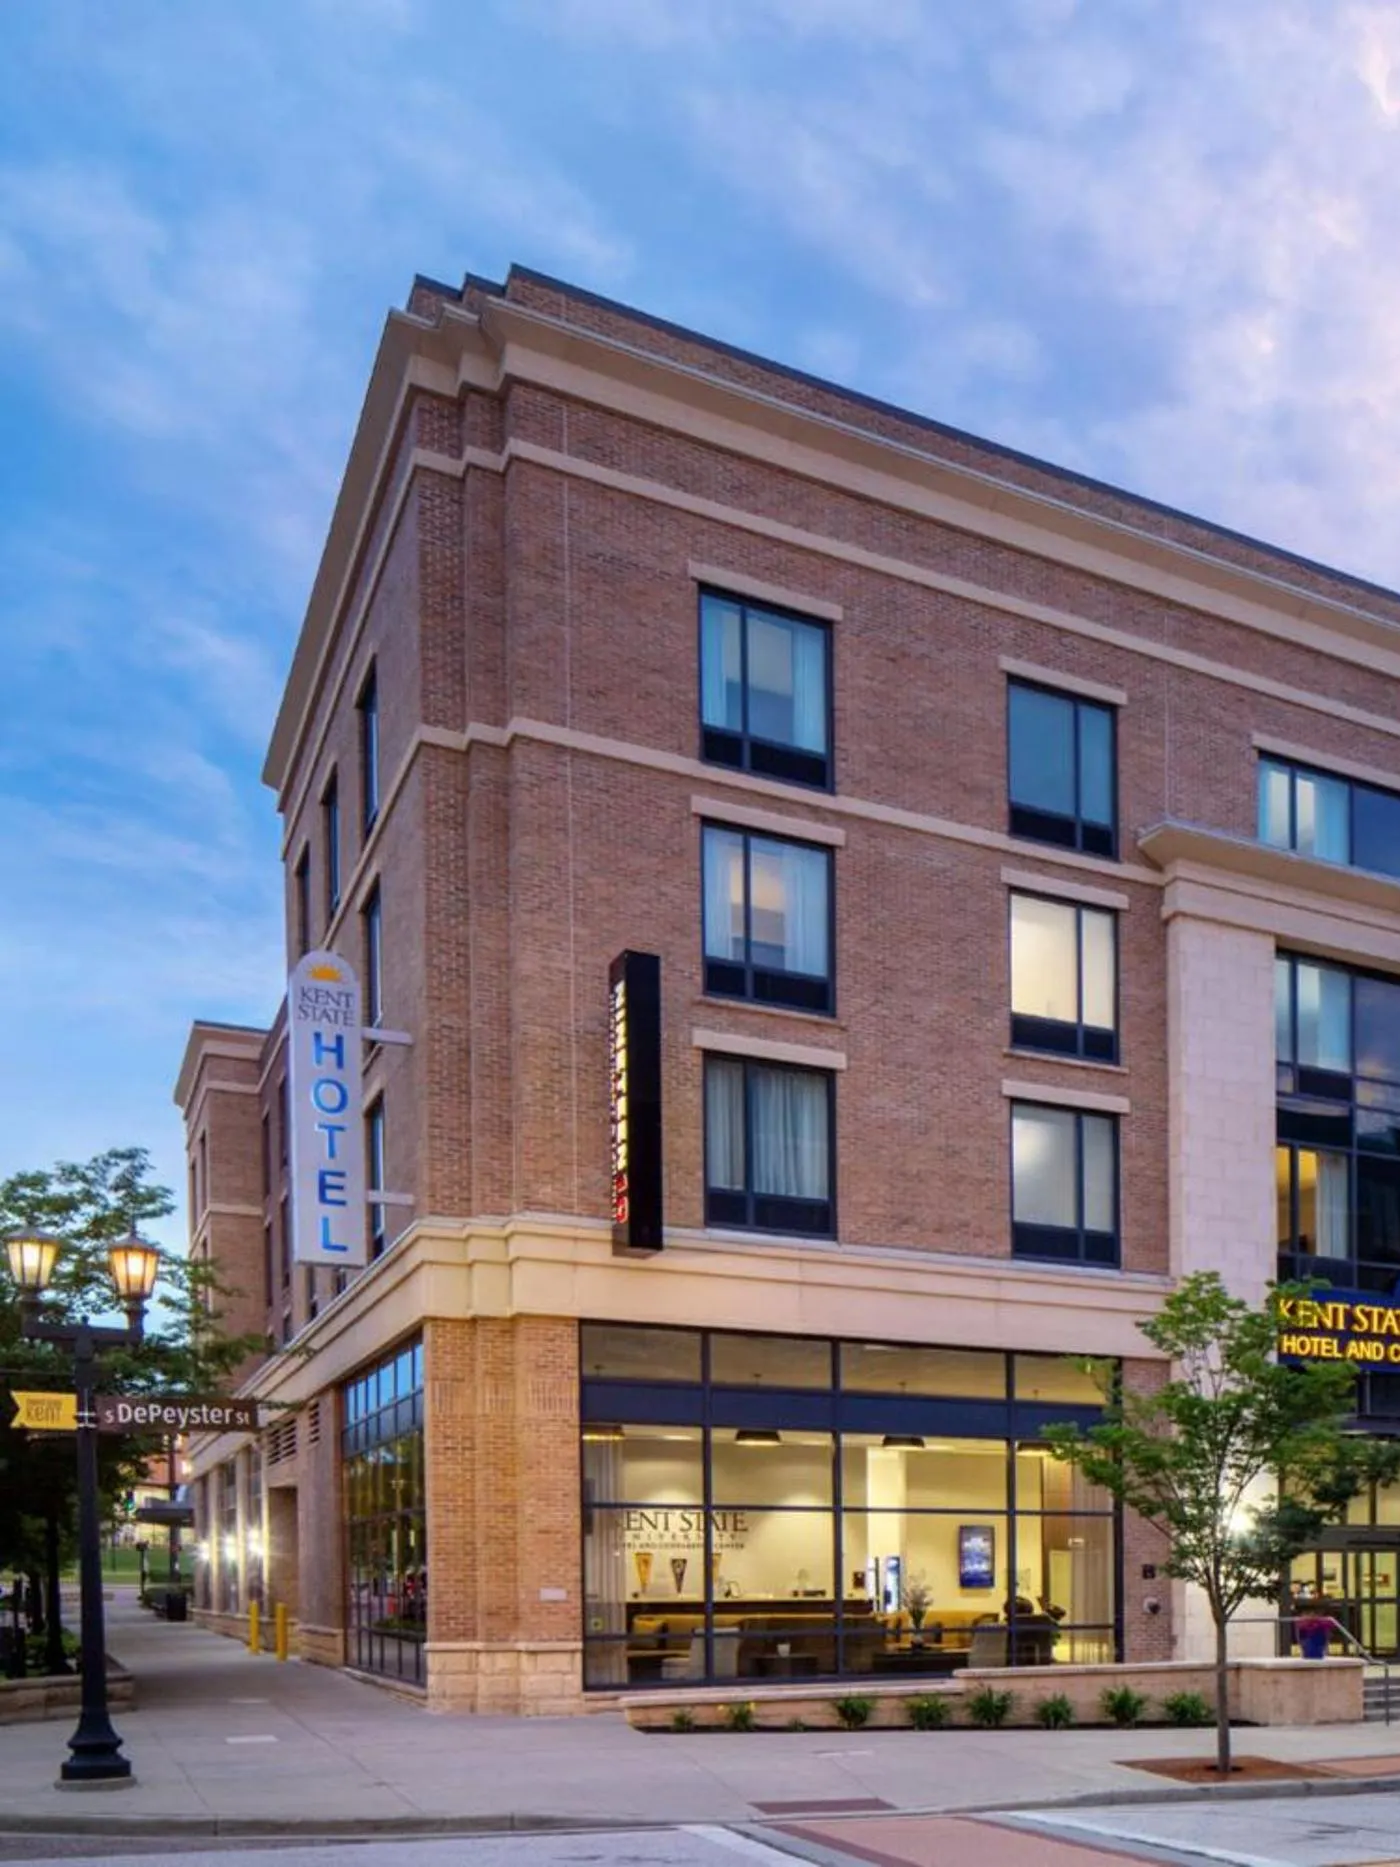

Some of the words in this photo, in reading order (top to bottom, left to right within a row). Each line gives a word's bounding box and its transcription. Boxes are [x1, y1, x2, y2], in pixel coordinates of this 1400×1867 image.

[300, 986, 354, 1009] KENT
[299, 1004, 356, 1027] STATE
[311, 1031, 349, 1252] HOTEL
[1280, 1298, 1350, 1330] KENT
[1282, 1334, 1342, 1359] HOTEL
[1346, 1340, 1384, 1361] AND
[105, 1409, 115, 1424] S
[117, 1403, 234, 1429] DePeyster
[616, 1510, 679, 1531] ENT
